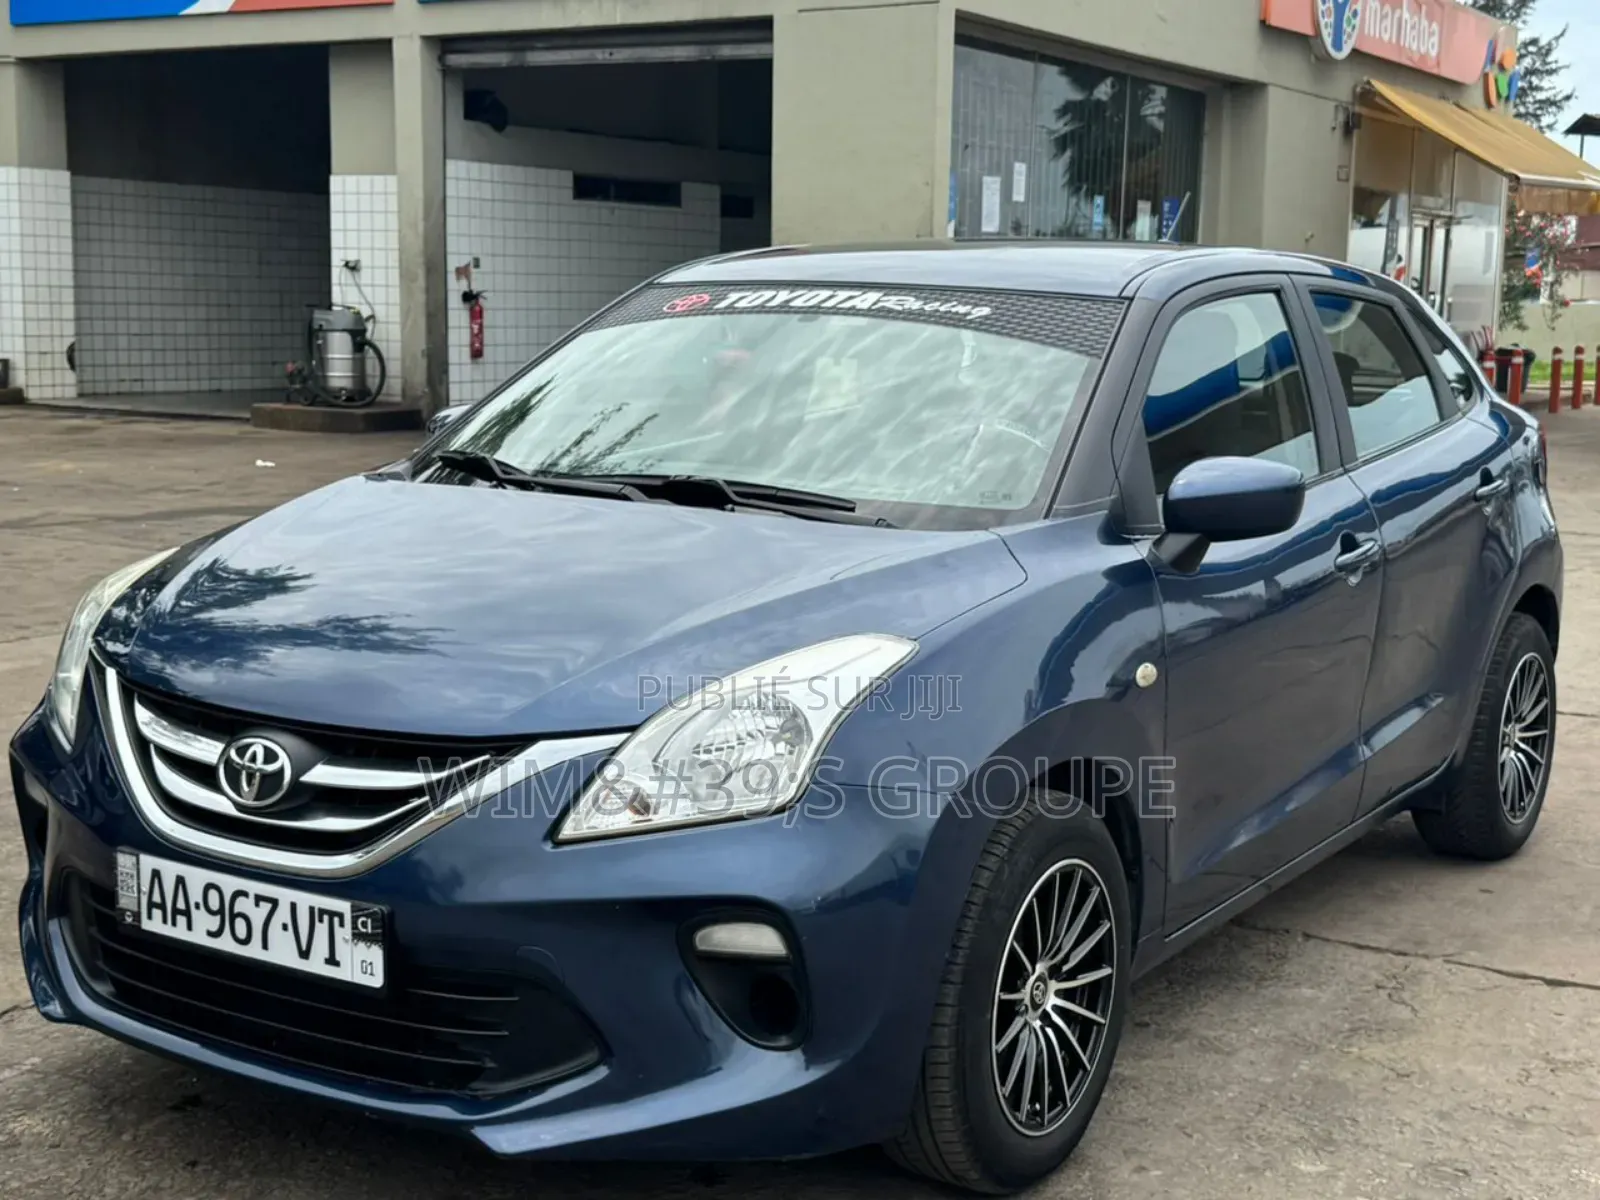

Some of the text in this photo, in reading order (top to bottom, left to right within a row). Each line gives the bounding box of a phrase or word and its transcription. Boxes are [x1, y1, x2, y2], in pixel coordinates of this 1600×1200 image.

[1363, 0, 1439, 57] marhaba
[713, 289, 993, 320] TOYOTA Racing
